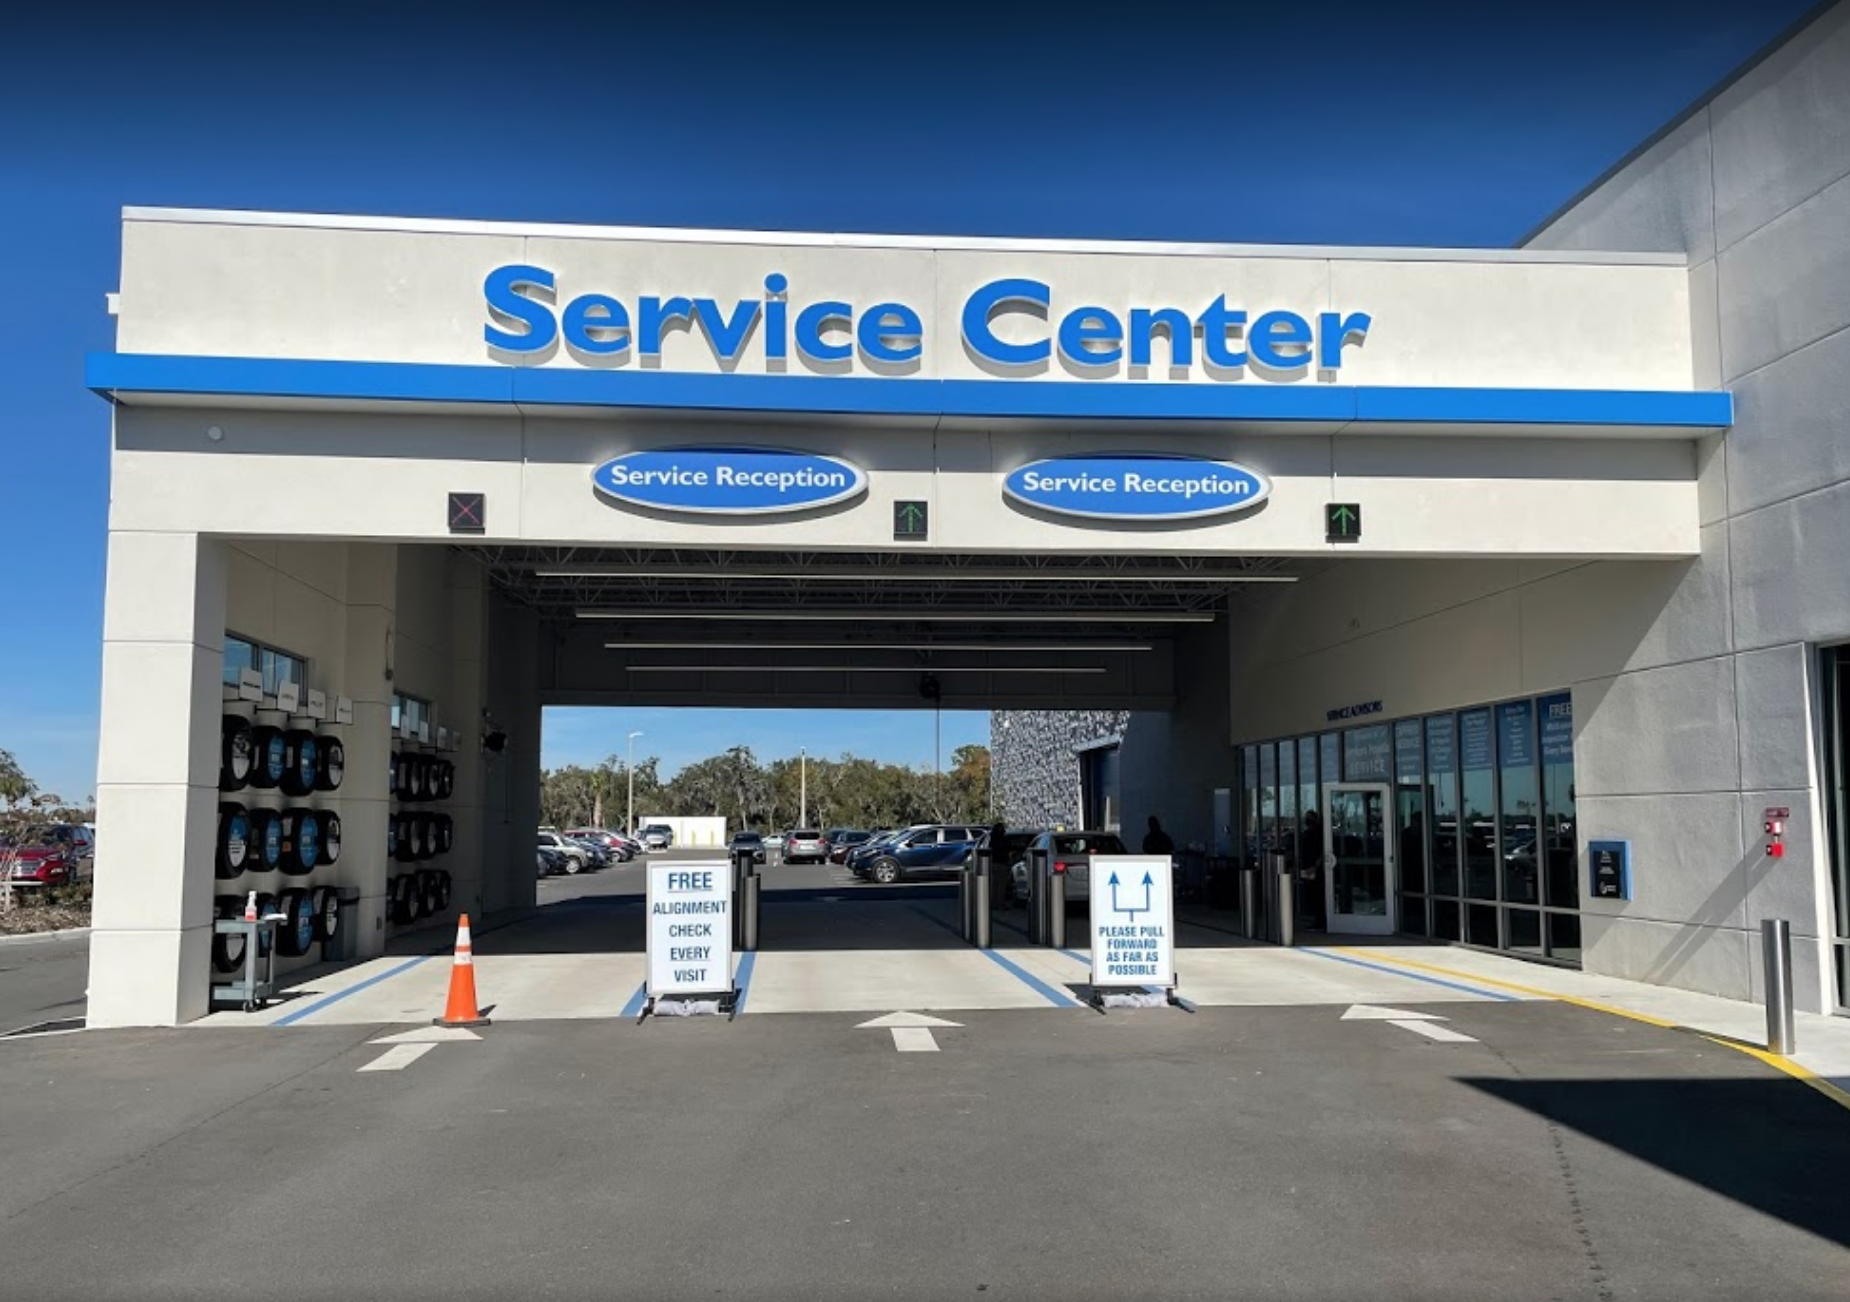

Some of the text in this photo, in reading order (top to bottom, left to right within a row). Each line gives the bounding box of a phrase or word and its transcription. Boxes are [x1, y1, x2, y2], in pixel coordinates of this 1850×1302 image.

[484, 264, 1372, 370] Service Center
[610, 464, 846, 492] Service Reception
[1022, 471, 1250, 498] Service Reception
[667, 871, 713, 890] FREE
[653, 900, 727, 915] ALIGNMENT
[669, 923, 712, 938] CHECK
[1099, 927, 1164, 937] PLEASE PULL
[1107, 939, 1157, 949] FORWARD
[670, 946, 711, 961] EVERY
[1106, 951, 1159, 962] AS FAR AS
[674, 968, 707, 983] VISIT
[1109, 965, 1156, 975] POSSIBLE
